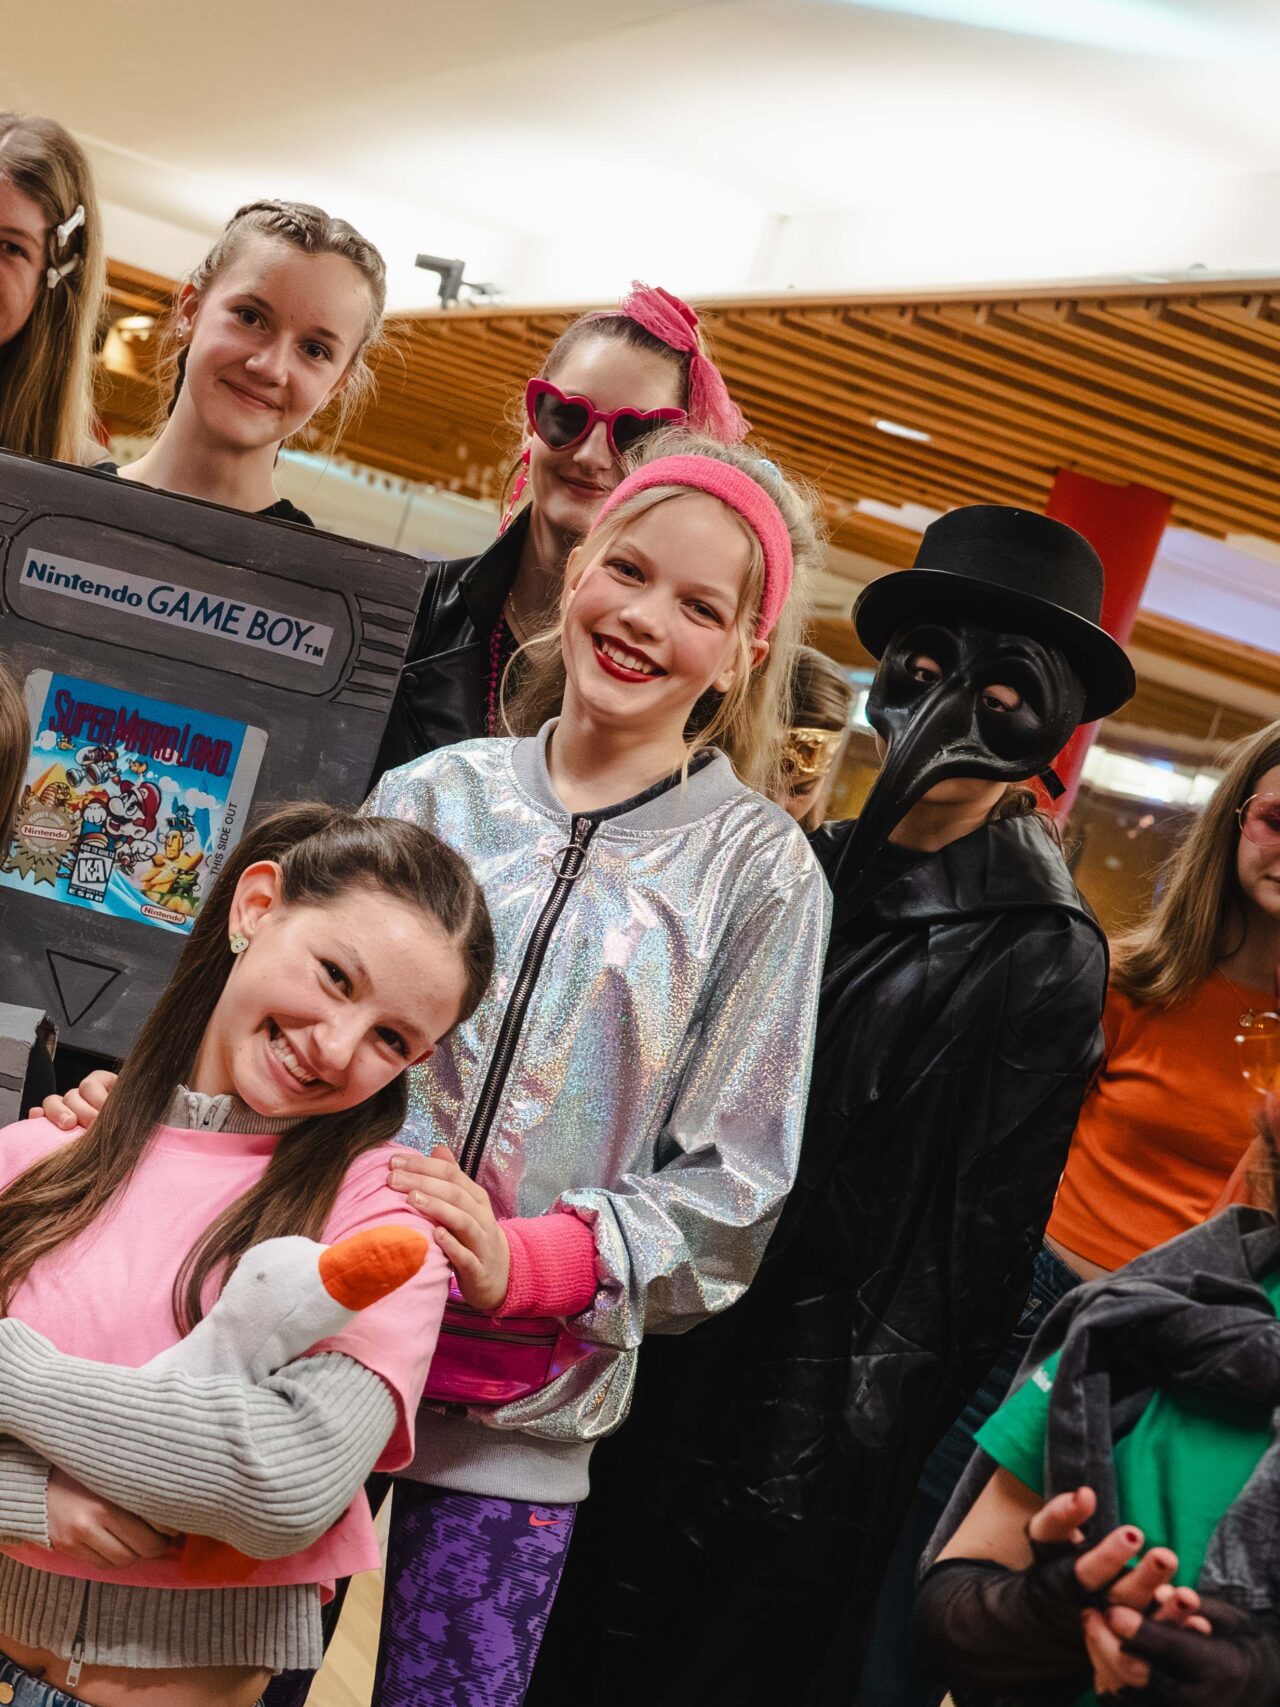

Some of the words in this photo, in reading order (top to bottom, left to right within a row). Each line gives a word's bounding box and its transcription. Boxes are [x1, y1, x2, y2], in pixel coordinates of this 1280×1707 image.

[26, 559, 143, 608] Nintendo
[146, 586, 245, 636] GAME
[246, 610, 315, 653] BOY
[49, 689, 117, 746] SUPER
[111, 706, 180, 763] MARIO
[176, 723, 232, 777] LAND
[24, 826, 68, 840] Nintendo
[210, 853, 224, 877] THIS
[218, 827, 231, 851] SIDE
[225, 802, 238, 825] OUT
[144, 906, 183, 922] Nintendo
